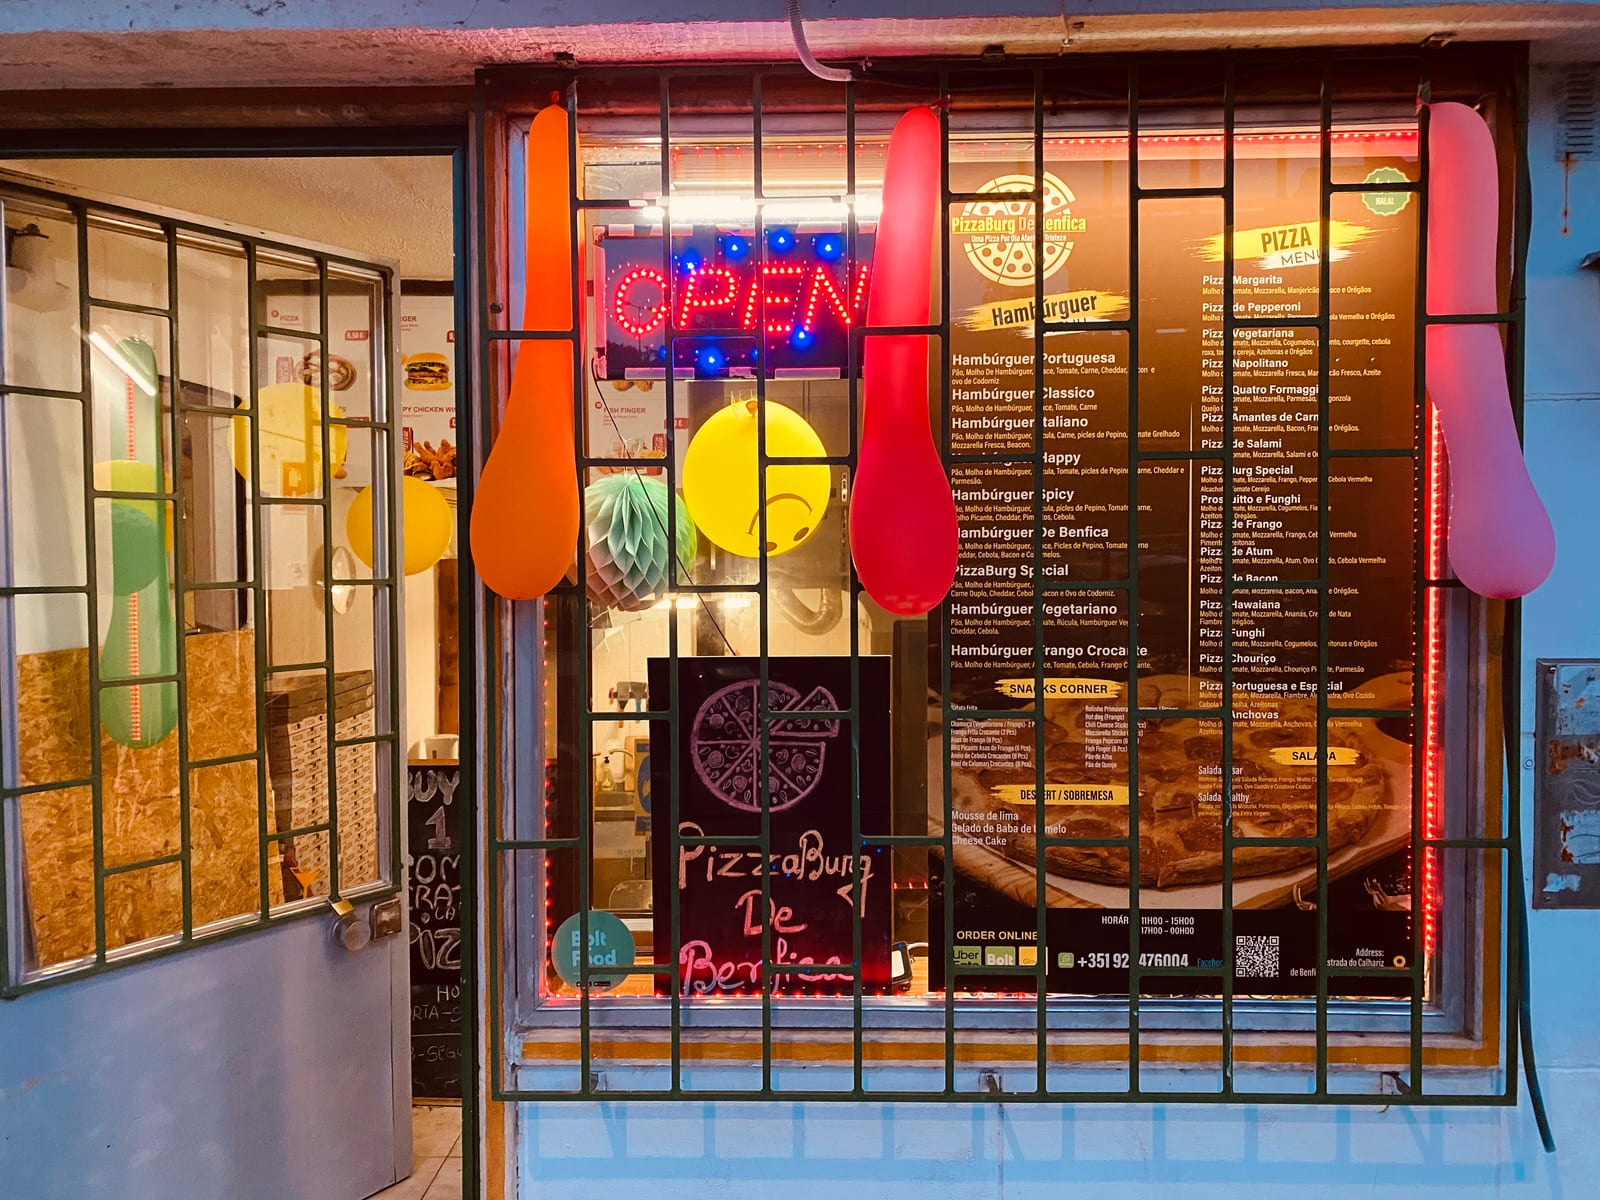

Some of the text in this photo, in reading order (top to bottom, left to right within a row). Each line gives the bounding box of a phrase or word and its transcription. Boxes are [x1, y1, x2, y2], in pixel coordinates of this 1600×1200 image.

[952, 215, 1086, 234] PizzaBurg De enfica
[1261, 227, 1312, 253] PIZZA
[1203, 275, 1282, 286] Pizz Margarita
[615, 264, 868, 336] OPEN
[992, 295, 1097, 326] Hambúrguer
[1203, 302, 1301, 314] Pizz de Pepperoni
[1202, 328, 1294, 339] Pizz Vegetariana
[952, 353, 1116, 367] Hambúrguer Portuguesa
[1202, 358, 1288, 370] Pizz Napolitano
[1056, 367, 1079, 375] Tomate,
[1081, 367, 1100, 375] Carne,
[1101, 366, 1128, 375] Cheddar,
[973, 377, 1000, 385] Codorniz
[952, 387, 1095, 402] Hambúrguer Classico
[1202, 385, 1319, 395] Pizz Quatro Formaggi
[1202, 412, 1319, 422] Pizz Amantes de Carn
[952, 416, 1088, 431] Hambúrguer taliano
[1202, 439, 1282, 448] Pizz de Salami
[1042, 453, 1081, 465] Happy
[1202, 464, 1293, 476] Pizzurg Special
[952, 489, 1074, 503] Hambúrguer Spicy
[1201, 495, 1254, 504] Prosuitto
[1265, 494, 1300, 505] Funghi
[1200, 519, 1282, 530] Pizz de Frango
[958, 526, 1034, 540] ambúrguer
[1059, 526, 1109, 538] Benfica
[1200, 547, 1273, 556] Pizz de Atum
[1200, 574, 1223, 583] Pizz
[951, 603, 1033, 617] Hambúrguer
[1232, 600, 1280, 609] Hawaiana
[1232, 628, 1265, 639] Funghi
[951, 645, 1033, 659] Hambúrguer
[1043, 645, 1084, 658] rango
[1231, 654, 1276, 665] Chouriço
[1010, 684, 1108, 694] SNAKS CORNER
[1231, 682, 1288, 692] Portuguesa
[1300, 681, 1343, 692] Espial
[1231, 710, 1279, 719] Anchovas
[1292, 752, 1336, 761] SALAA
[1199, 766, 1222, 775] Salada
[1020, 790, 1055, 800] DESERT
[1063, 790, 1114, 800] SOBREMESA
[1199, 793, 1222, 802] Salada
[952, 810, 1019, 821] Mousse de lima
[425, 806, 451, 849] 1
[952, 823, 1067, 834] Gelado de Baba de melo
[952, 835, 1007, 846] Cheese Cake
[678, 821, 875, 918] PizzaBurg
[735, 890, 808, 936] De
[1102, 915, 1129, 924] HORÁR
[1141, 917, 1162, 925] 11H00
[1171, 917, 1194, 925] 15H00
[572, 930, 606, 946] Bolt
[957, 931, 1037, 940] ORDER ONLINE
[954, 950, 979, 959] Uber
[1356, 948, 1384, 956] Address:
[987, 953, 1013, 965] Bolt
[1077, 953, 1110, 968] +351
[1113, 953, 1129, 968] 92
[1327, 958, 1384, 967] strada do Calhariz
[1290, 968, 1316, 976] de Benfi
